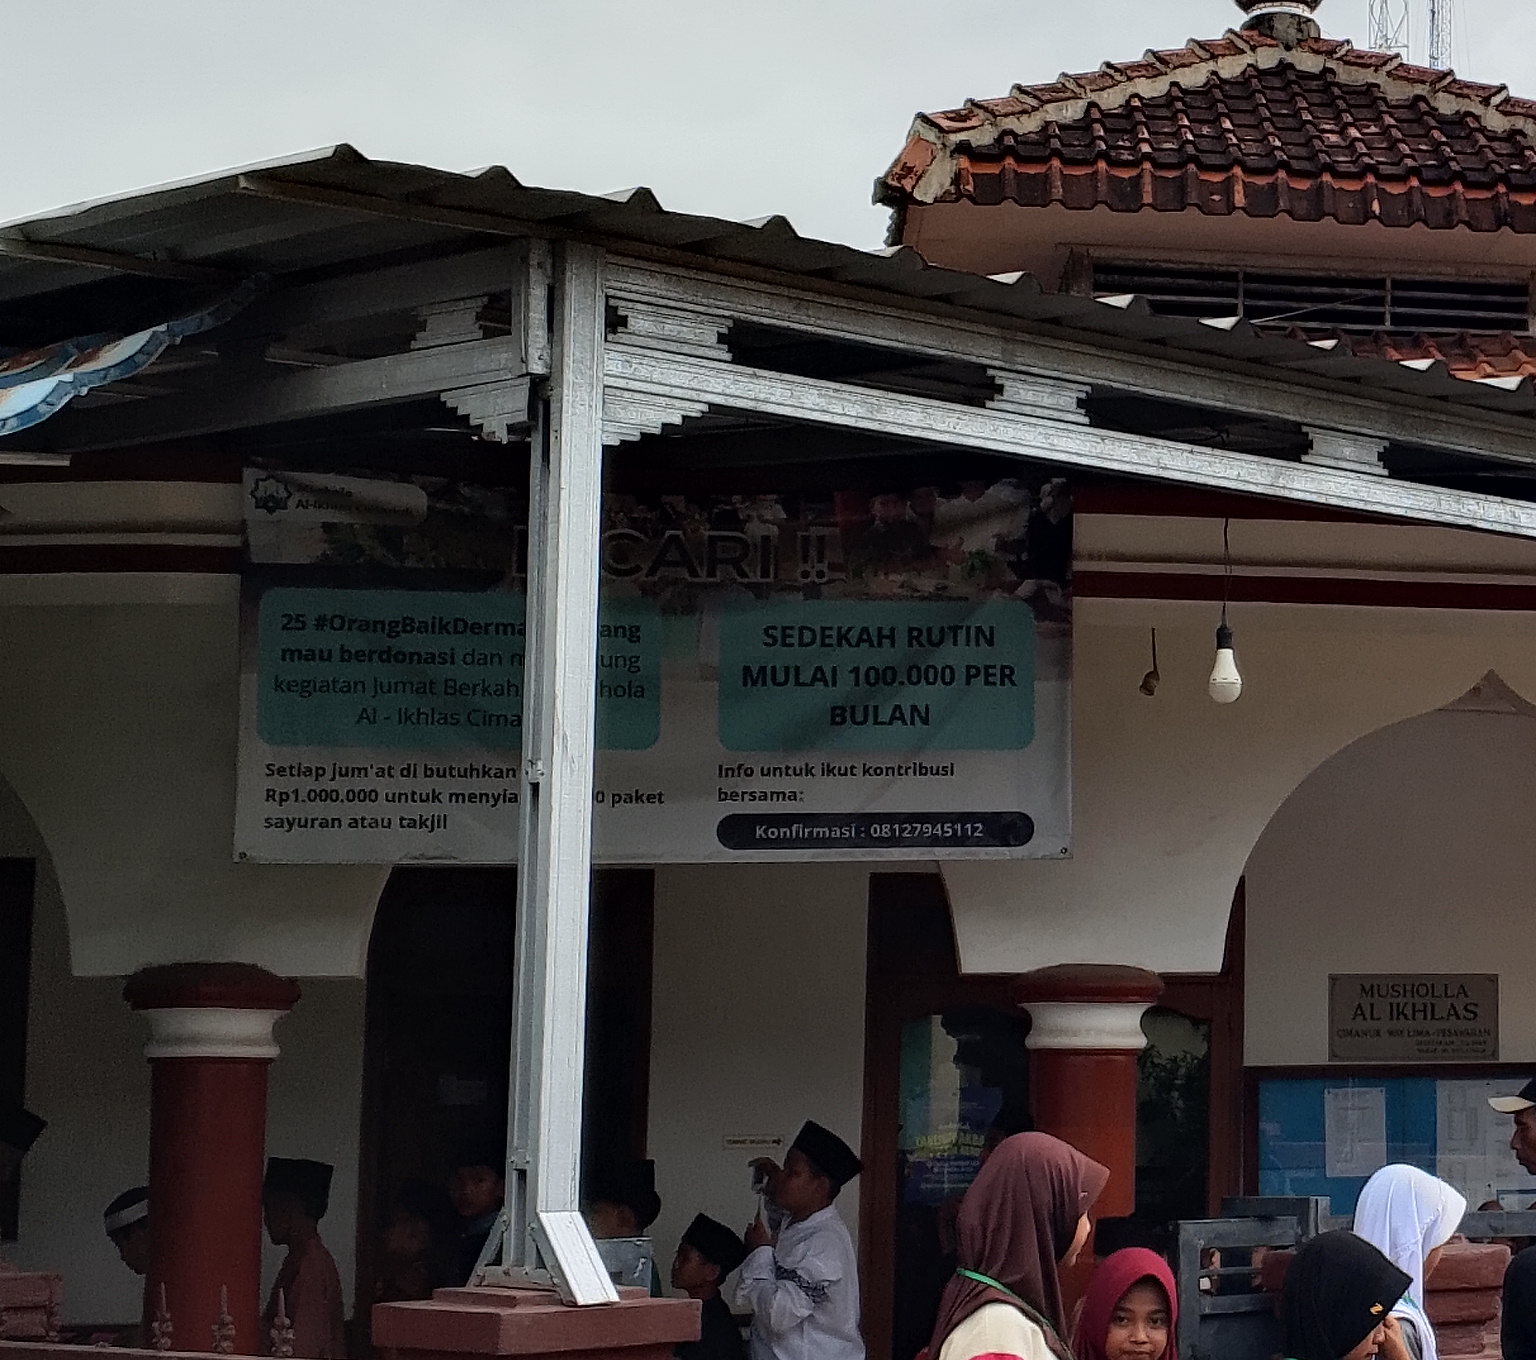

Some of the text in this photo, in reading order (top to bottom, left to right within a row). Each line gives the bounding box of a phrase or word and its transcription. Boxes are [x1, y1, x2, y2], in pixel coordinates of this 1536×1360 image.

[281, 613, 306, 631] 25
[762, 624, 995, 648] SEDEKAH RUTIN
[281, 648, 331, 663] mau
[340, 644, 455, 665] berdonasi
[462, 647, 503, 666] dan
[273, 675, 366, 698] kegiatan
[444, 678, 518, 697] Berkah
[741, 665, 1017, 688] MULAI 100.000 PER
[356, 706, 377, 725] Al
[398, 707, 460, 726] Ikhlas
[829, 704, 930, 727] BULAN
[265, 762, 327, 781] Setiap
[400, 763, 418, 779] di
[423, 762, 517, 780] butuhkan
[717, 761, 955, 778] Info untuk ikut kontribusi
[264, 788, 379, 806] Rp1.000.000
[384, 788, 443, 804] untuk
[610, 789, 664, 807] paket
[717, 786, 805, 803] bersama:
[264, 813, 448, 833] sayuran atau takjil
[755, 822, 857, 841] Konfirmasi
[1359, 982, 1470, 999] MUSHOLLA
[1351, 1001, 1479, 1022] AL IKHLAS
